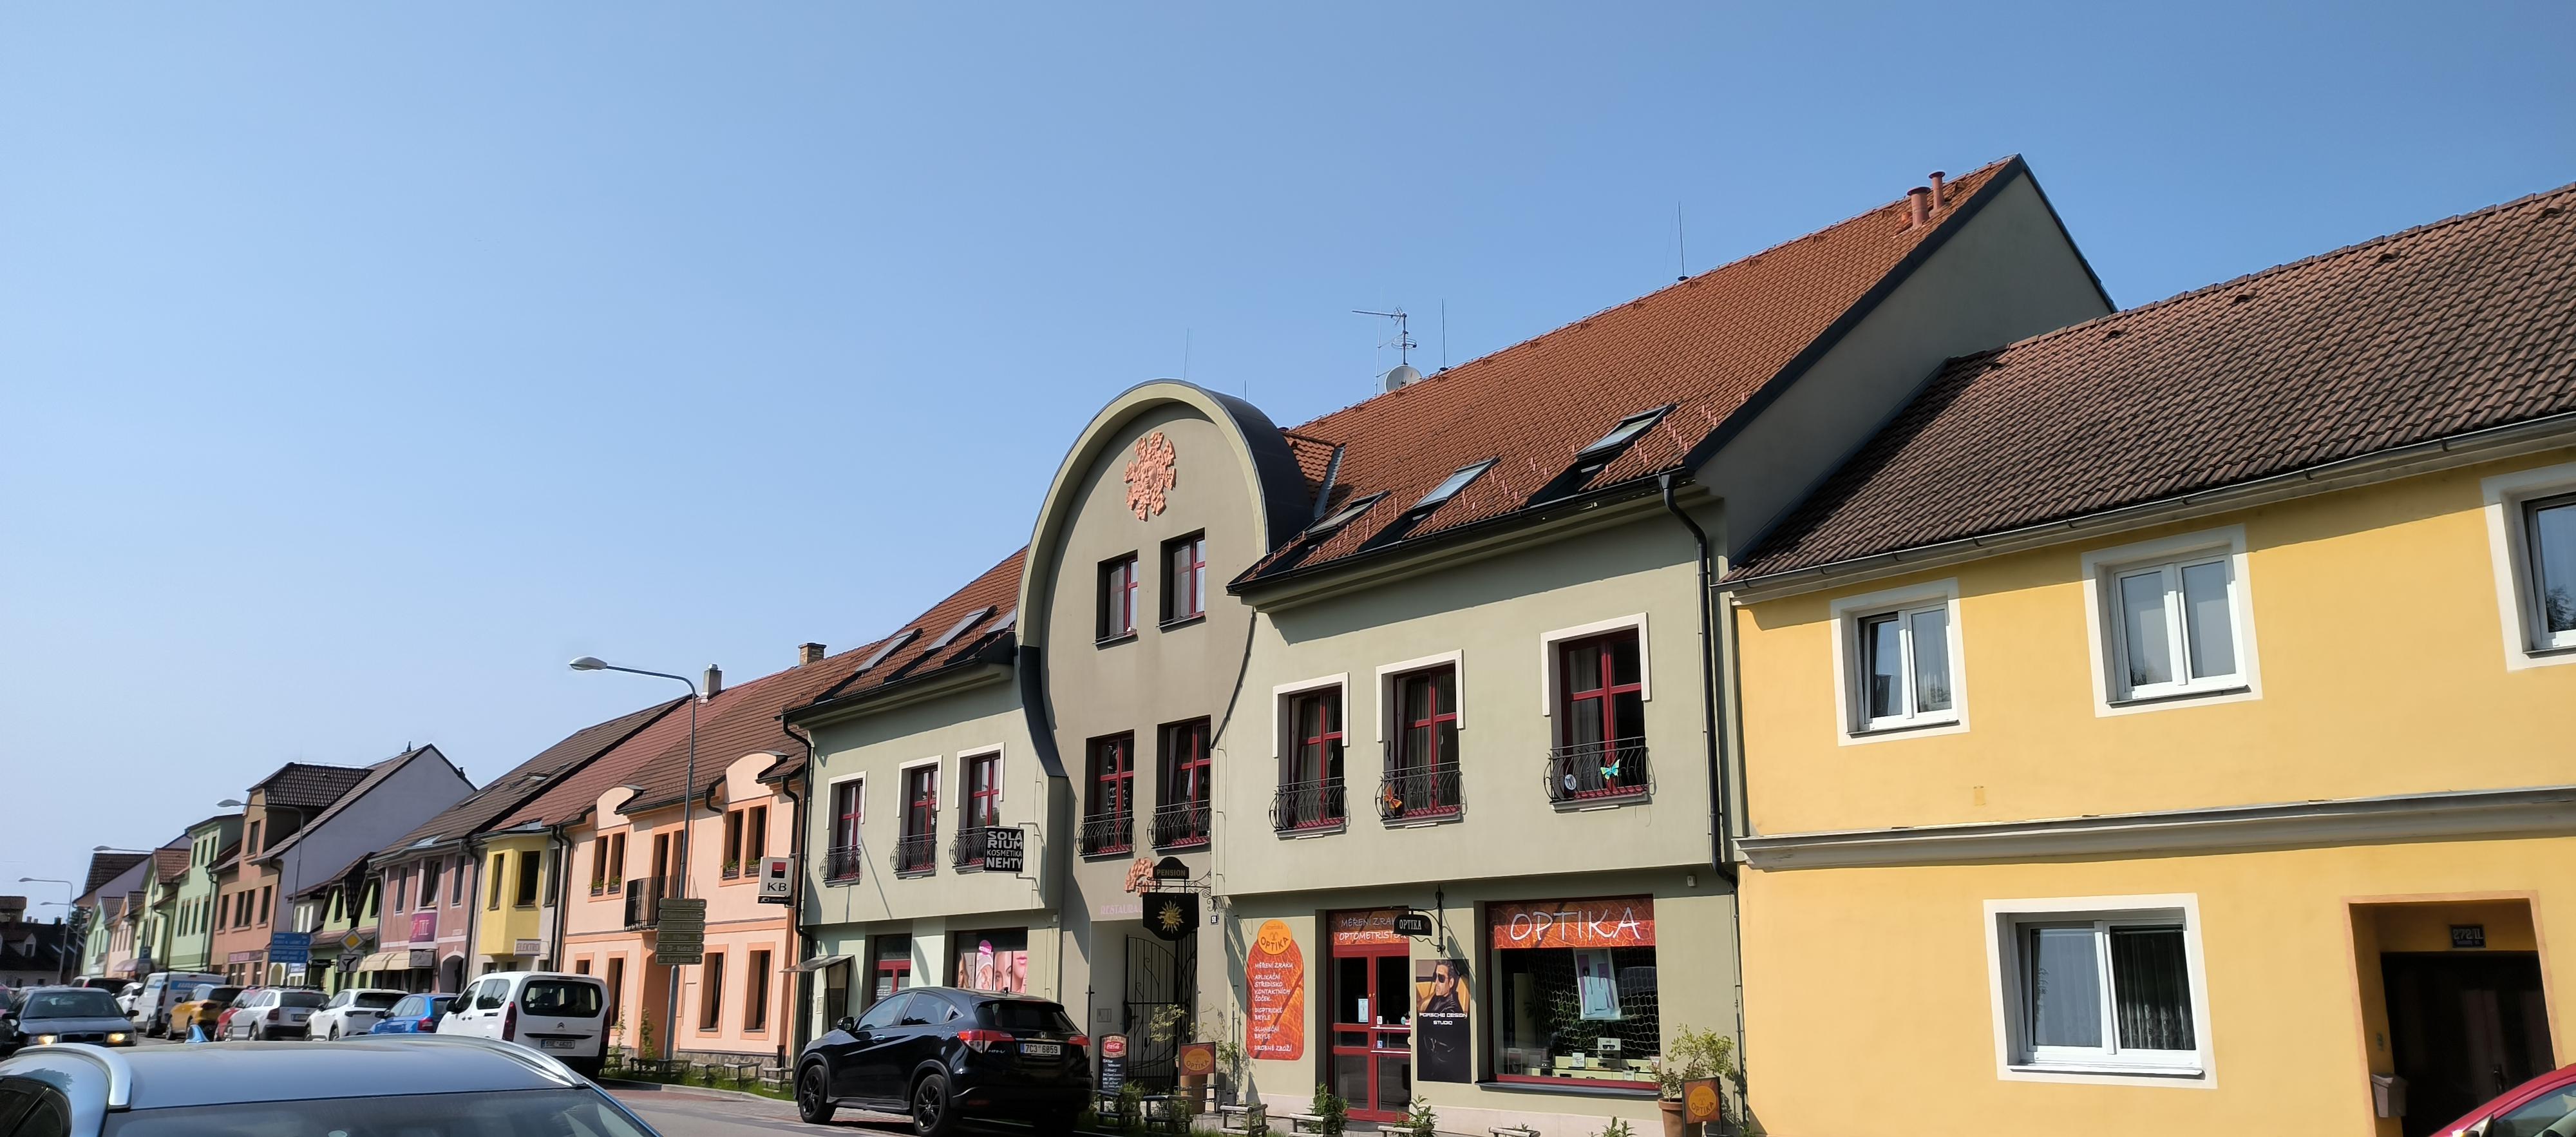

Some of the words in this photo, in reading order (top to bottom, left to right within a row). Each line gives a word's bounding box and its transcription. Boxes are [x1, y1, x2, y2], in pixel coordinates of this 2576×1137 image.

[987, 839, 1023, 850] RIUM
[987, 849, 1023, 857] KOSMETIKA
[986, 857, 1023, 869] NEHTY
[767, 881, 787, 892] KB
[1101, 904, 1143, 915] RESTAURAC
[1341, 917, 1372, 928] MĚŘENÍ
[1372, 917, 1396, 926] ZRAK
[1399, 919, 1423, 930] OPTIKA
[1510, 906, 1641, 941] OPTIKA
[1260, 936, 1289, 951] OPTIKA
[1254, 987, 1291, 995] KONTAKTNÍCH
[1041, 1046, 1058, 1054] 6859
[1186, 1059, 1209, 1069] OPTIKA
[1691, 1102, 1714, 1114] OPTIKA
